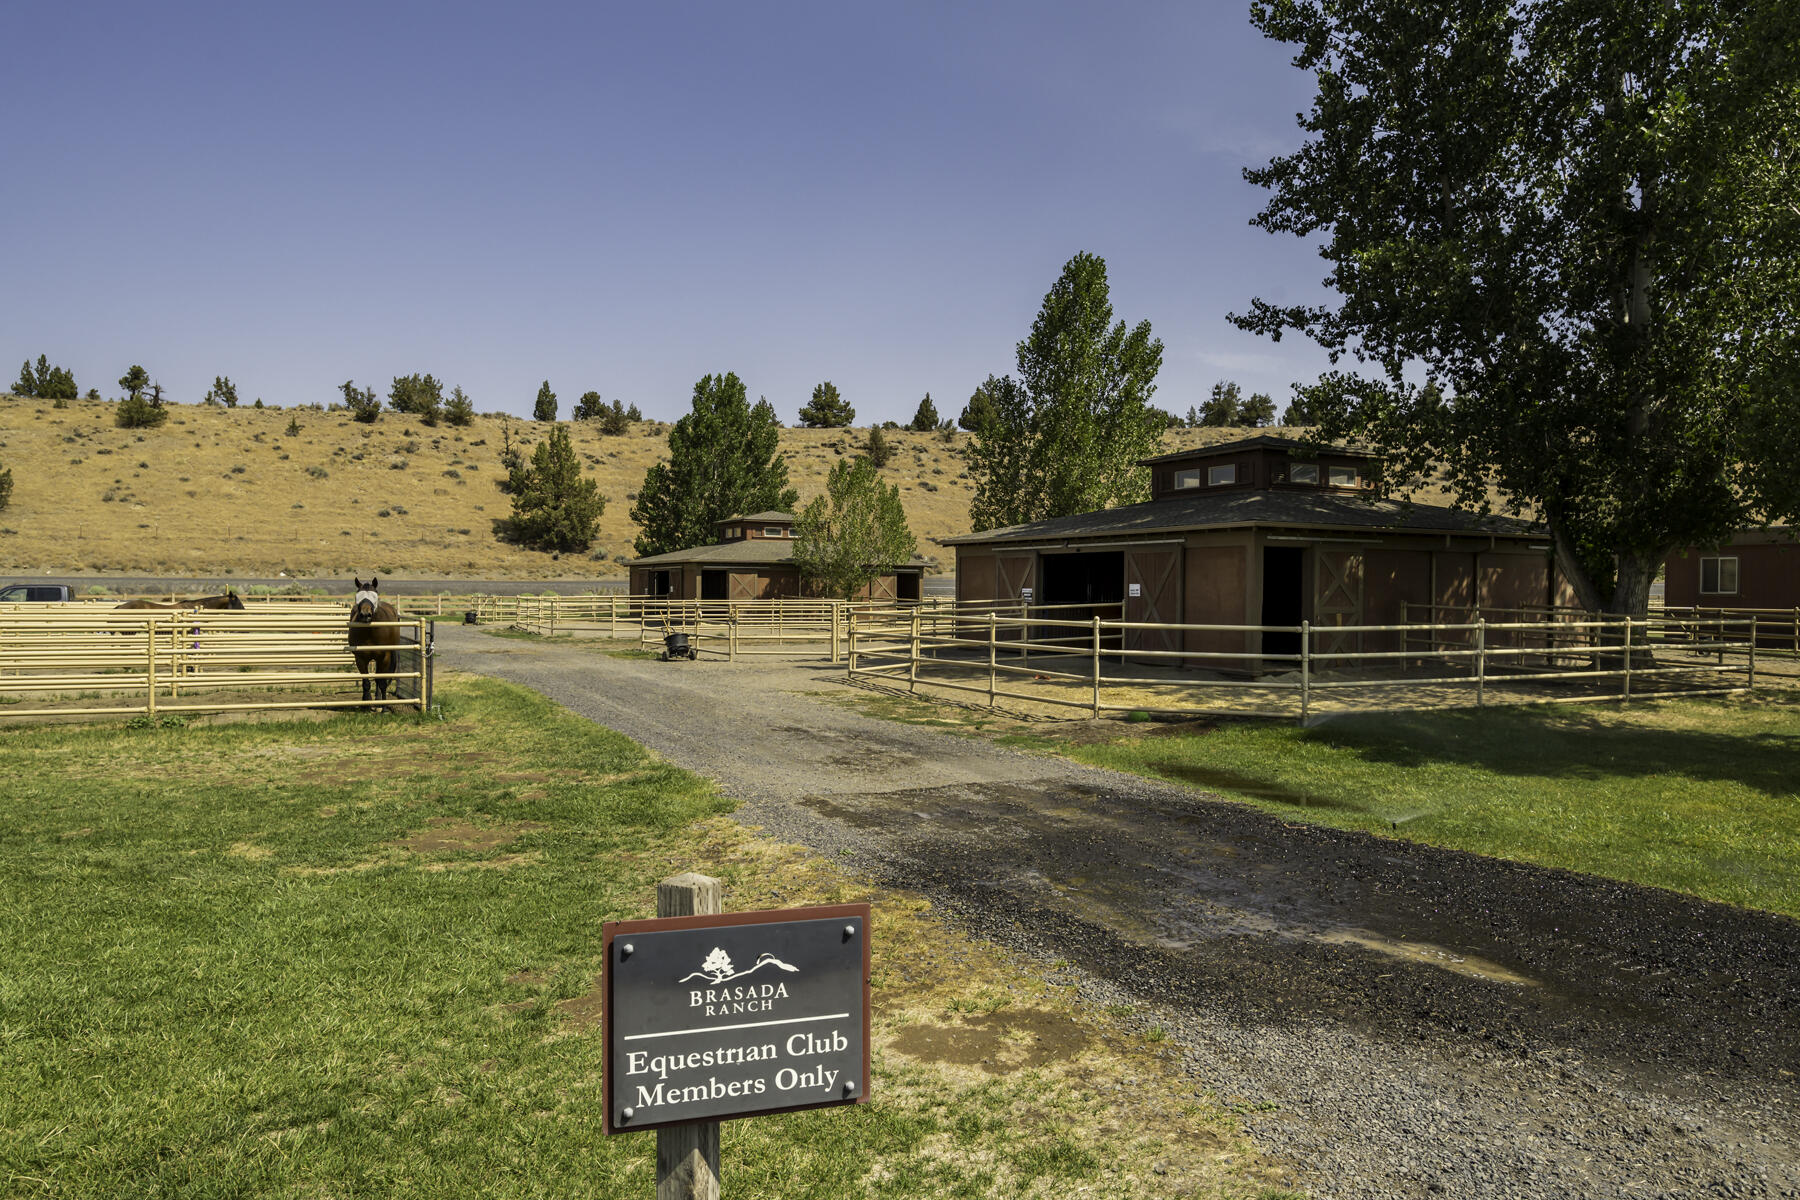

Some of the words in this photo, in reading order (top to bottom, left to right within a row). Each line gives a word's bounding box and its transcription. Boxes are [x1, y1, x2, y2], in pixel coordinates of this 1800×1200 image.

[689, 982, 789, 1007] BRASADA
[705, 1000, 773, 1016] RANCH
[625, 1042, 778, 1080] Equestrian
[786, 1030, 848, 1058] Club
[635, 1076, 766, 1109] Members
[775, 1064, 839, 1092] Only
